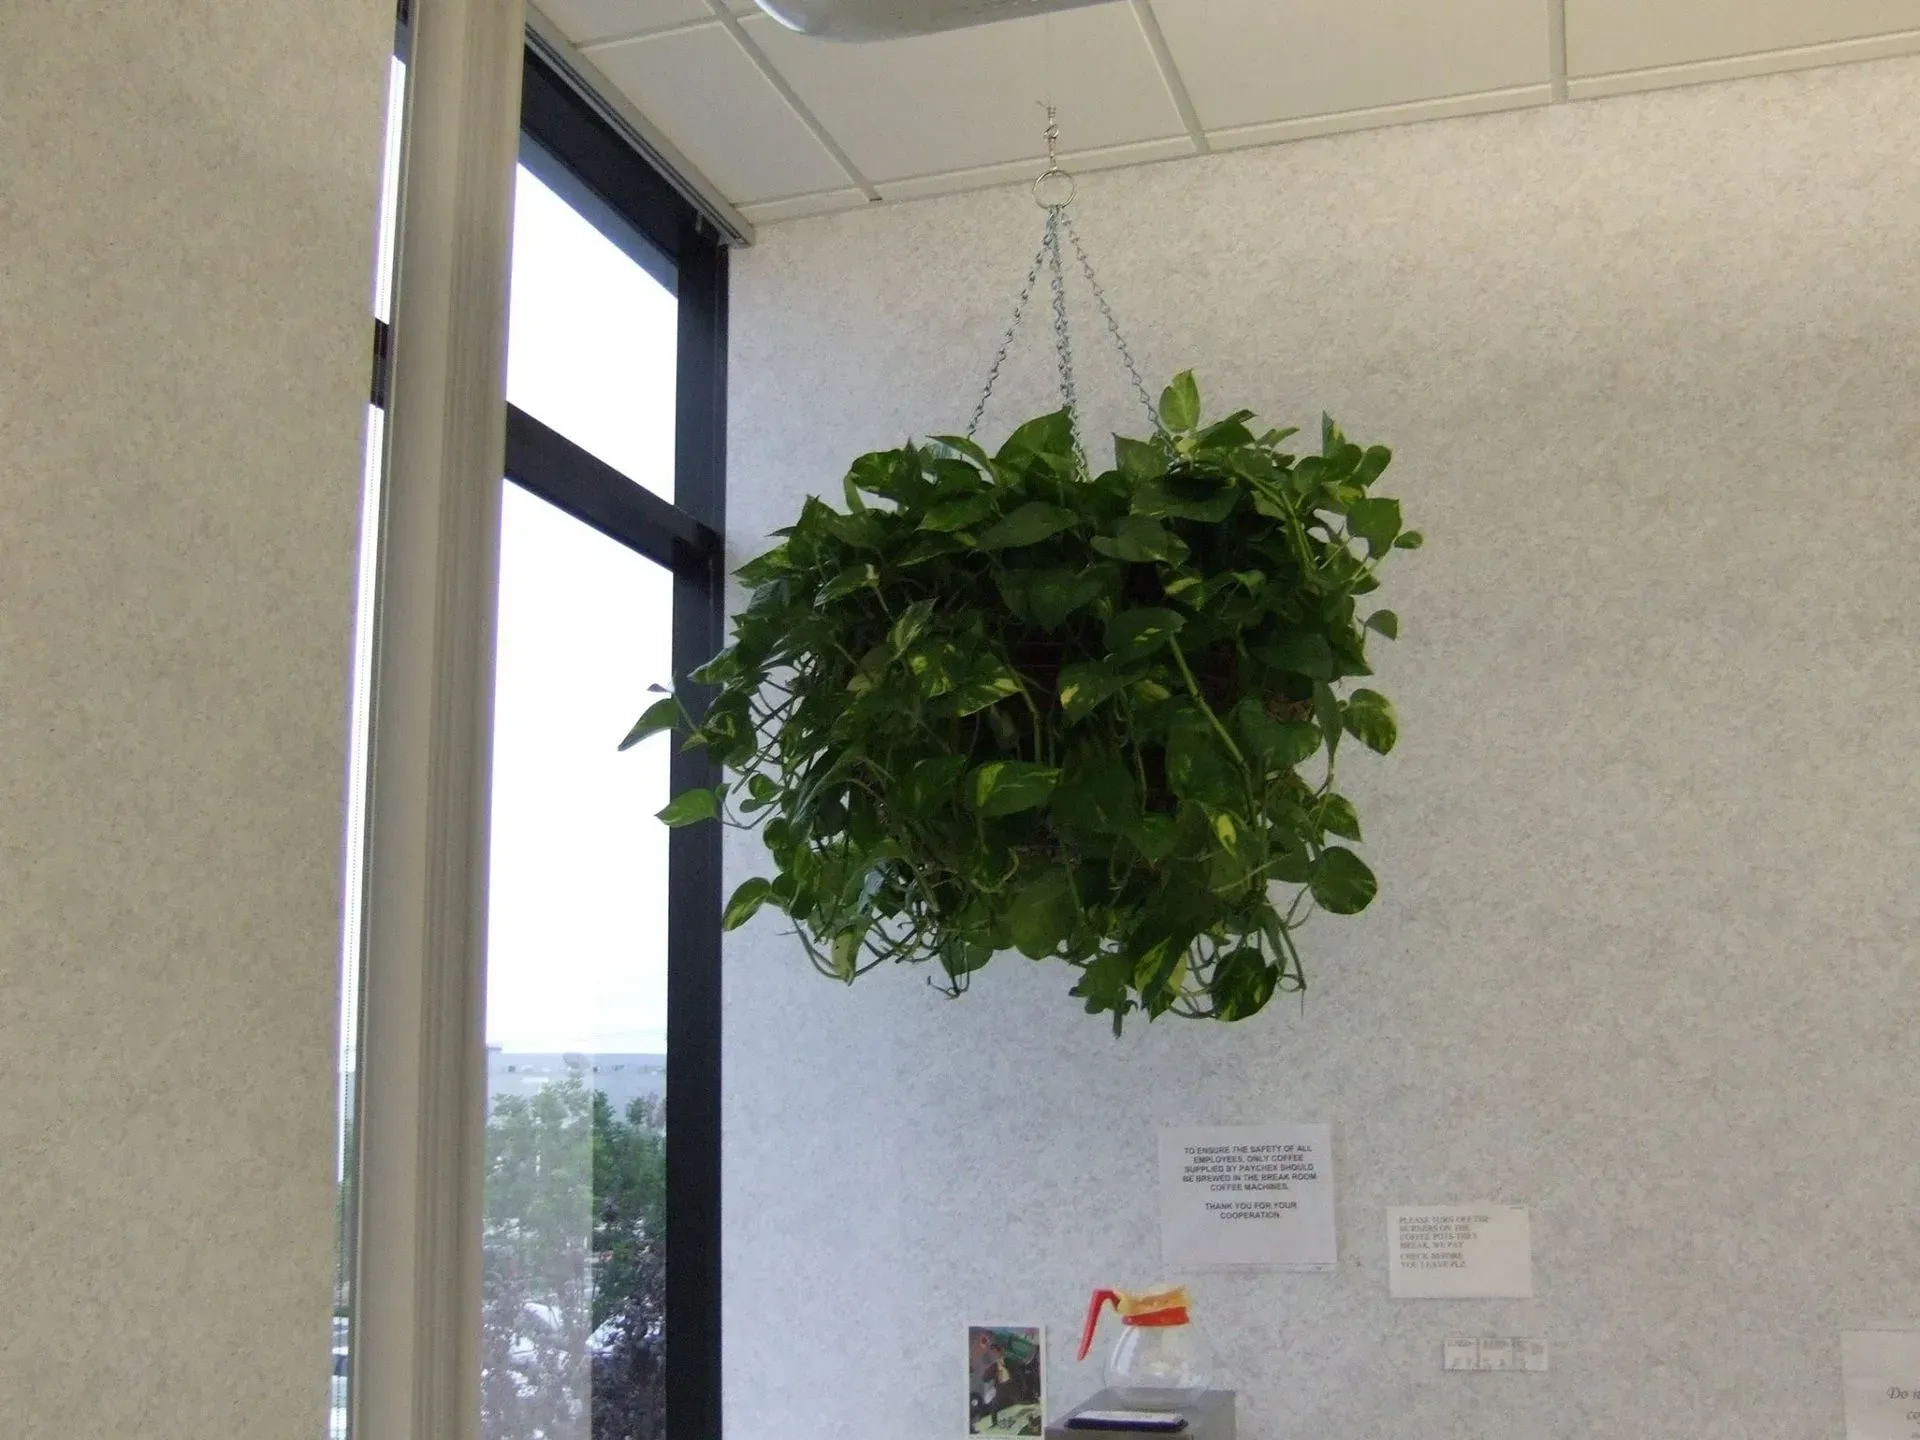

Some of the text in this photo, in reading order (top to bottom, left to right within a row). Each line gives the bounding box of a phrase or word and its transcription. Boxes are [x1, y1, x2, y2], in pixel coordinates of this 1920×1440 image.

[1184, 1145, 1312, 1155] TO ENSURE THE SAFETY OF ALL
[1246, 1155, 1270, 1163] ONLY
[1271, 1154, 1304, 1162] COFFEE
[1184, 1163, 1314, 1174] SUPPLIED BY PAYCHEX SHOULD
[1182, 1174, 1194, 1183] BE
[1196, 1174, 1232, 1182] BREWED
[1261, 1173, 1290, 1181] BREAK
[1291, 1172, 1317, 1180] ROOM
[1210, 1183, 1243, 1192] COFFEE
[1205, 1201, 1297, 1211] THANK YOU FOR YOUR
[1886, 1386, 1909, 1400] Do
